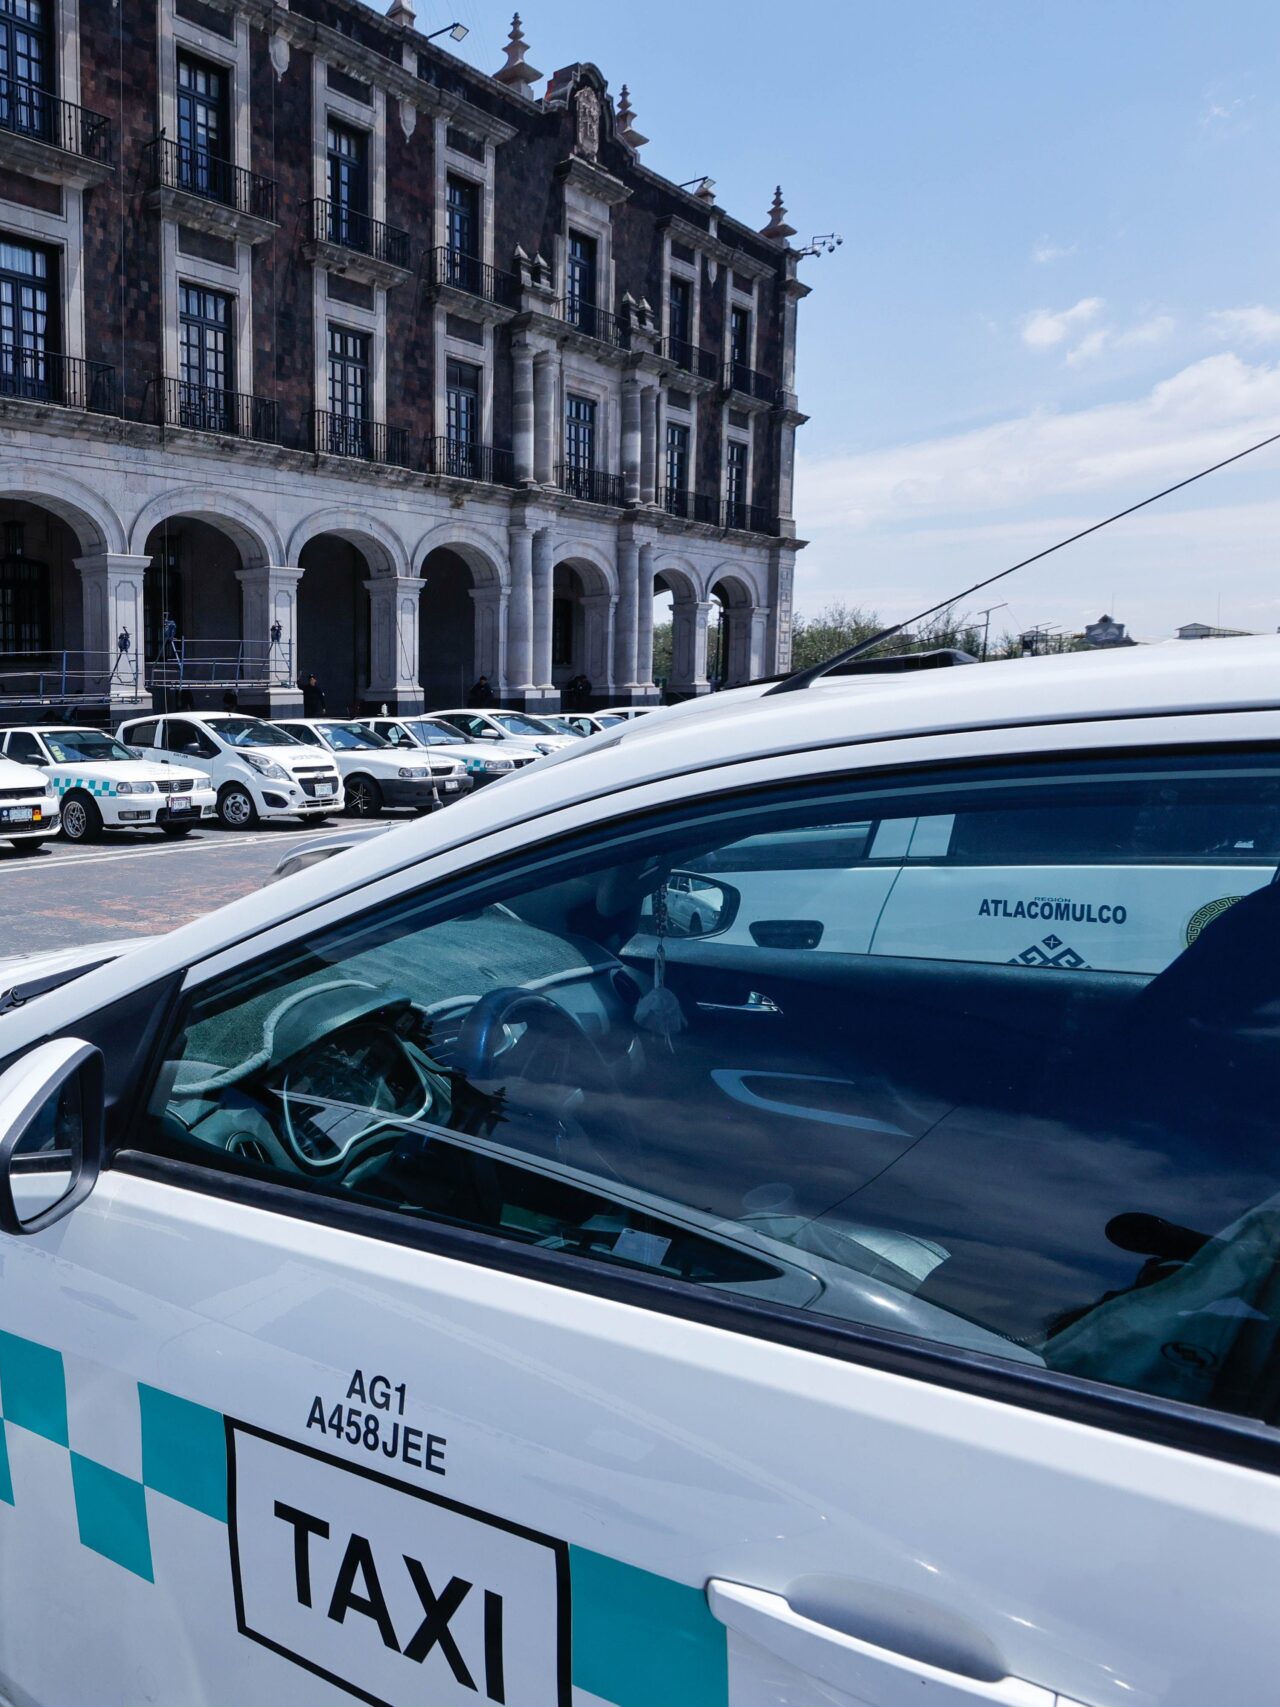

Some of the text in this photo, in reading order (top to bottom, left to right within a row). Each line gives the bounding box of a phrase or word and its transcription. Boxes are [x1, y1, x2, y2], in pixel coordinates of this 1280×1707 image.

[978, 898, 1127, 925] ATLACOMULCO
[346, 1369, 406, 1416] AG1
[306, 1395, 447, 1476] A458JEE
[274, 1499, 506, 1706] TAXI
